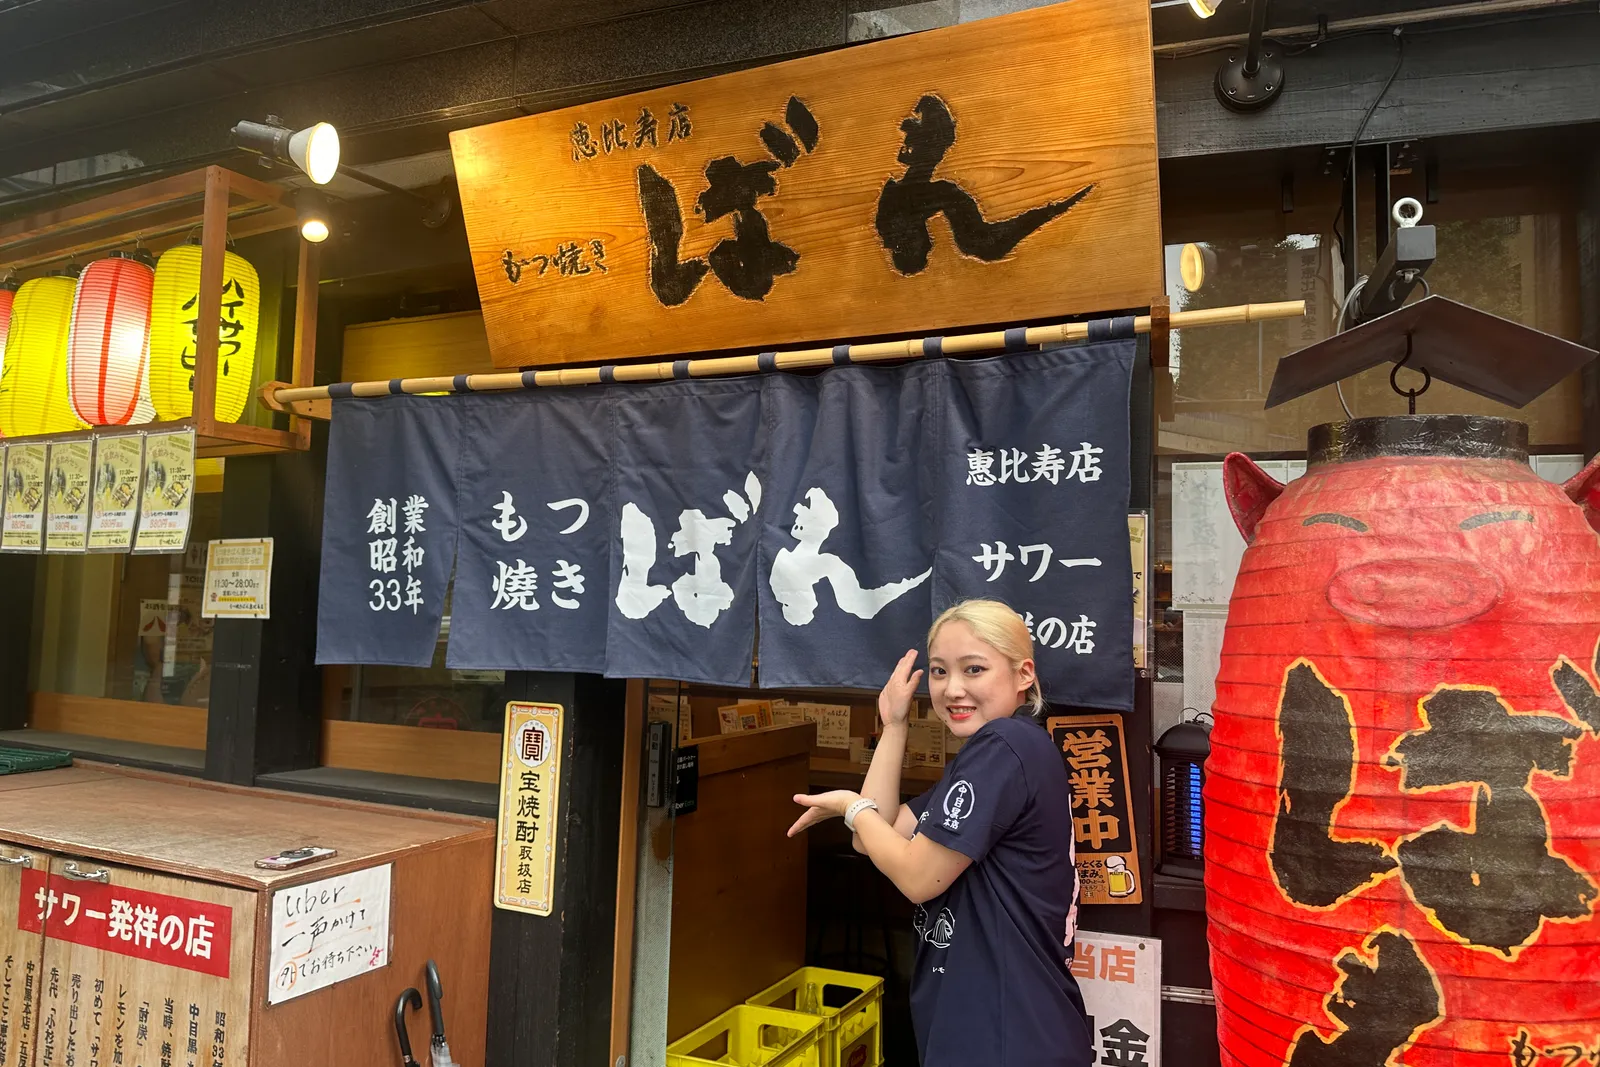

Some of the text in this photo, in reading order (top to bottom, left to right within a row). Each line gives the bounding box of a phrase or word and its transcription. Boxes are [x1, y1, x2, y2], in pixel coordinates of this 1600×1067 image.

[569, 102, 692, 162] 恵比寿店
[637, 93, 1098, 307] ばん
[502, 239, 608, 285] もつ焼き
[966, 442, 1104, 486] 恵比寿店
[366, 494, 429, 534] 創業
[492, 491, 590, 542] もつ
[368, 535, 425, 573] 昭和
[614, 470, 933, 629] ばん
[972, 541, 1102, 582] サワー
[369, 575, 424, 615] 33年
[949, 784, 968, 820] 中目黒
[1063, 729, 1120, 850] 営業中
[942, 817, 960, 830] 本店
[34, 886, 215, 960] サワー発祥の店
[281, 909, 366, 954] 一声かけて
[280, 945, 373, 987] 外でお待ち下さい
[1071, 942, 1136, 984] 当店
[1086, 1013, 1150, 1067] 金
